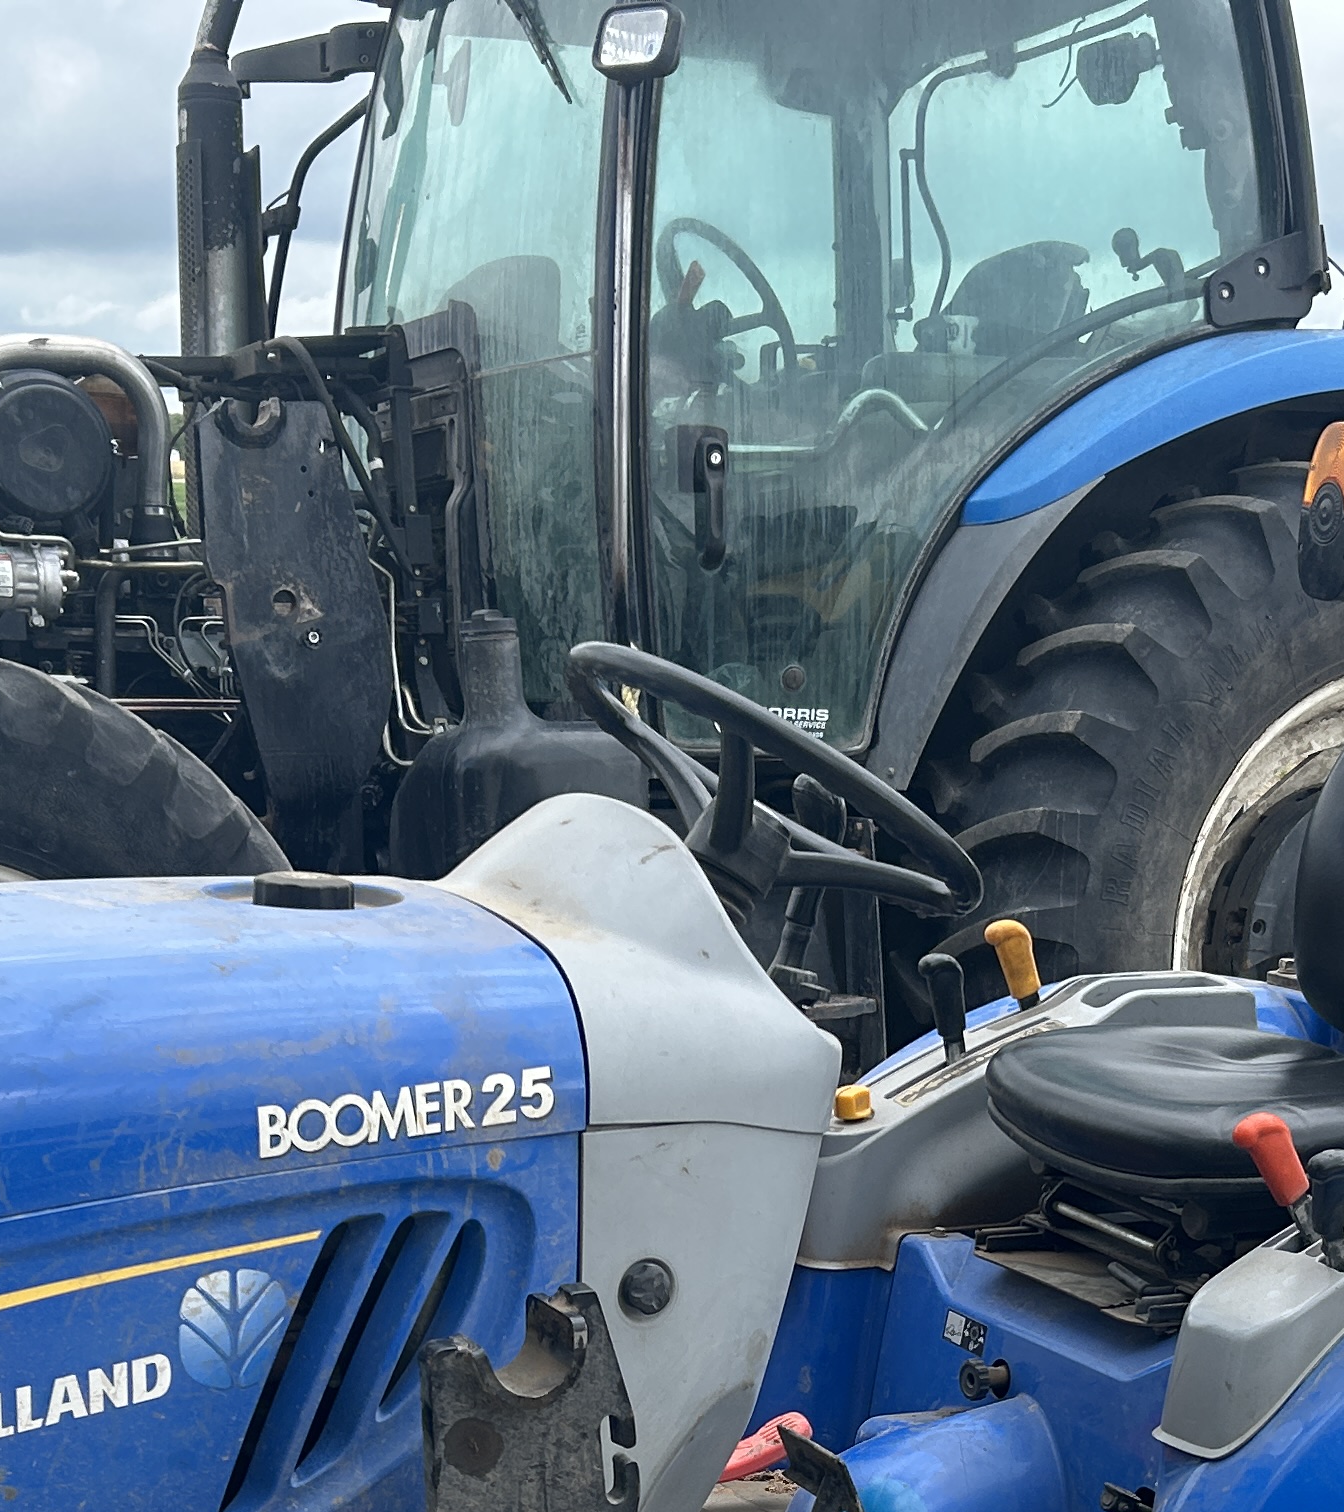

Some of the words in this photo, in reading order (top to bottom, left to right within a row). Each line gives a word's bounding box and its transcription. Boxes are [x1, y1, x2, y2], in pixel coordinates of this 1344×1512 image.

[762, 706, 829, 721] ORRIS
[257, 1078, 476, 1159] BOOMER
[481, 1066, 555, 1127] 25
